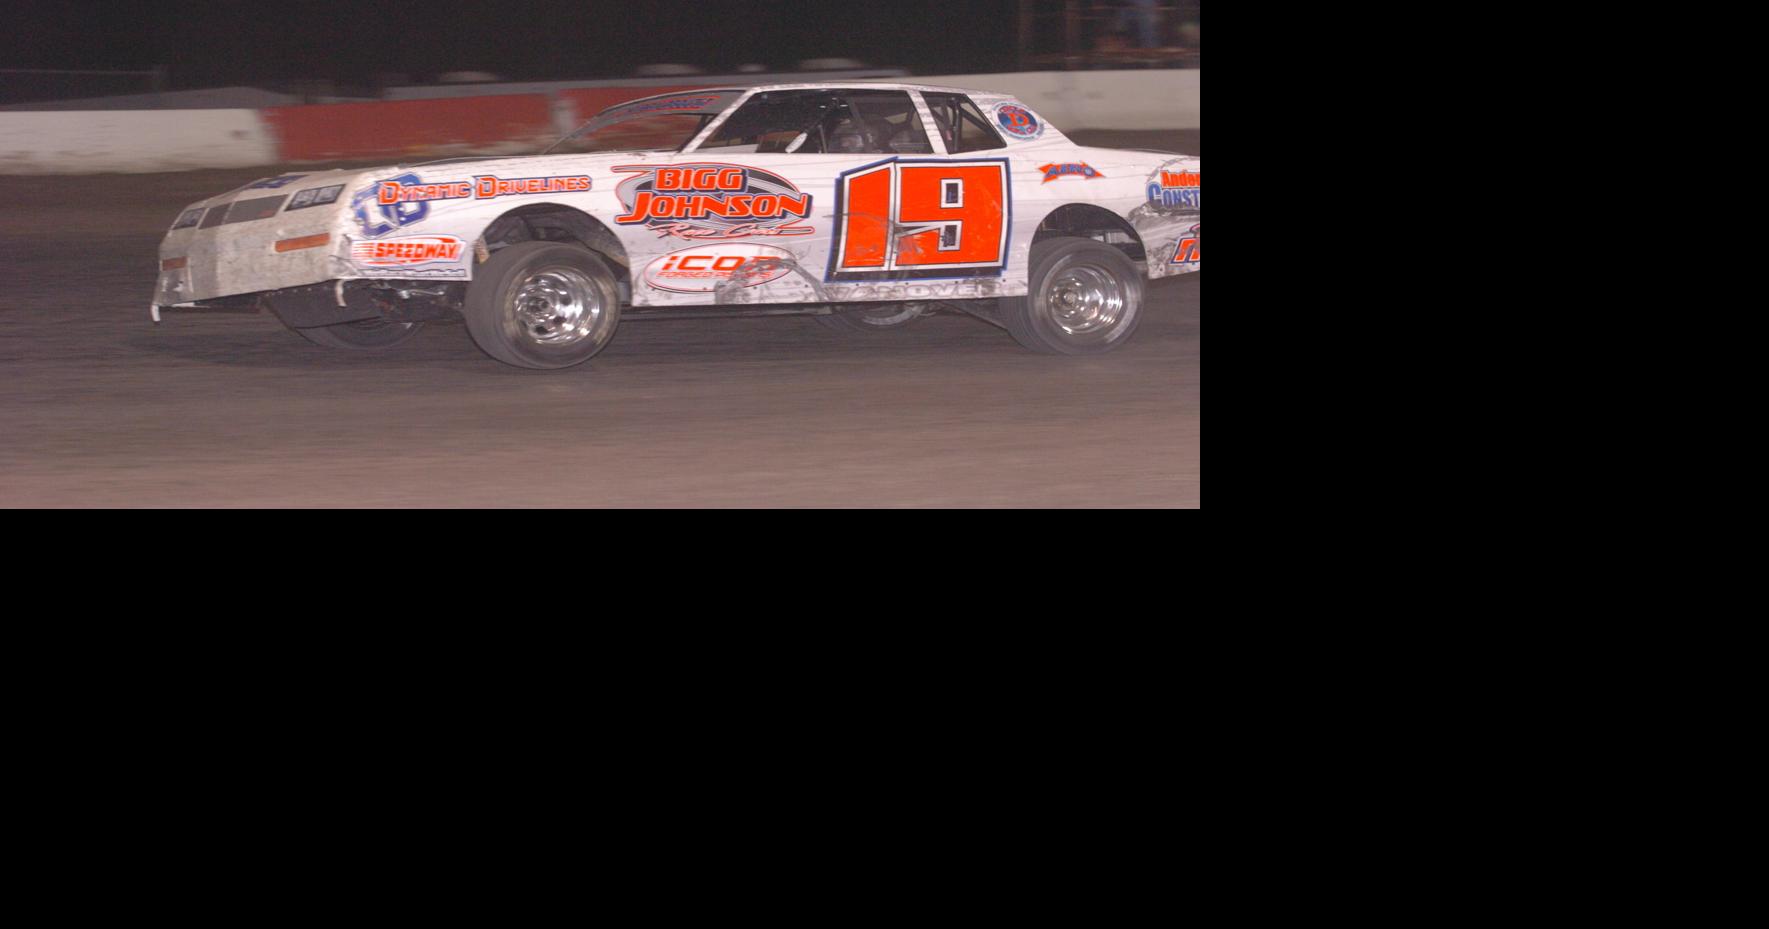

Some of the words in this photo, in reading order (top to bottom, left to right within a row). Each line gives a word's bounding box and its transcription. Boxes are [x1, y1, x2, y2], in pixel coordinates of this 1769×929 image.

[473, 175, 592, 199] DRIVELINES
[655, 167, 747, 191] BIGG
[614, 191, 813, 224] JOHNSON
[825, 156, 1012, 283] 19
[374, 242, 458, 258] SPEEDWAY
